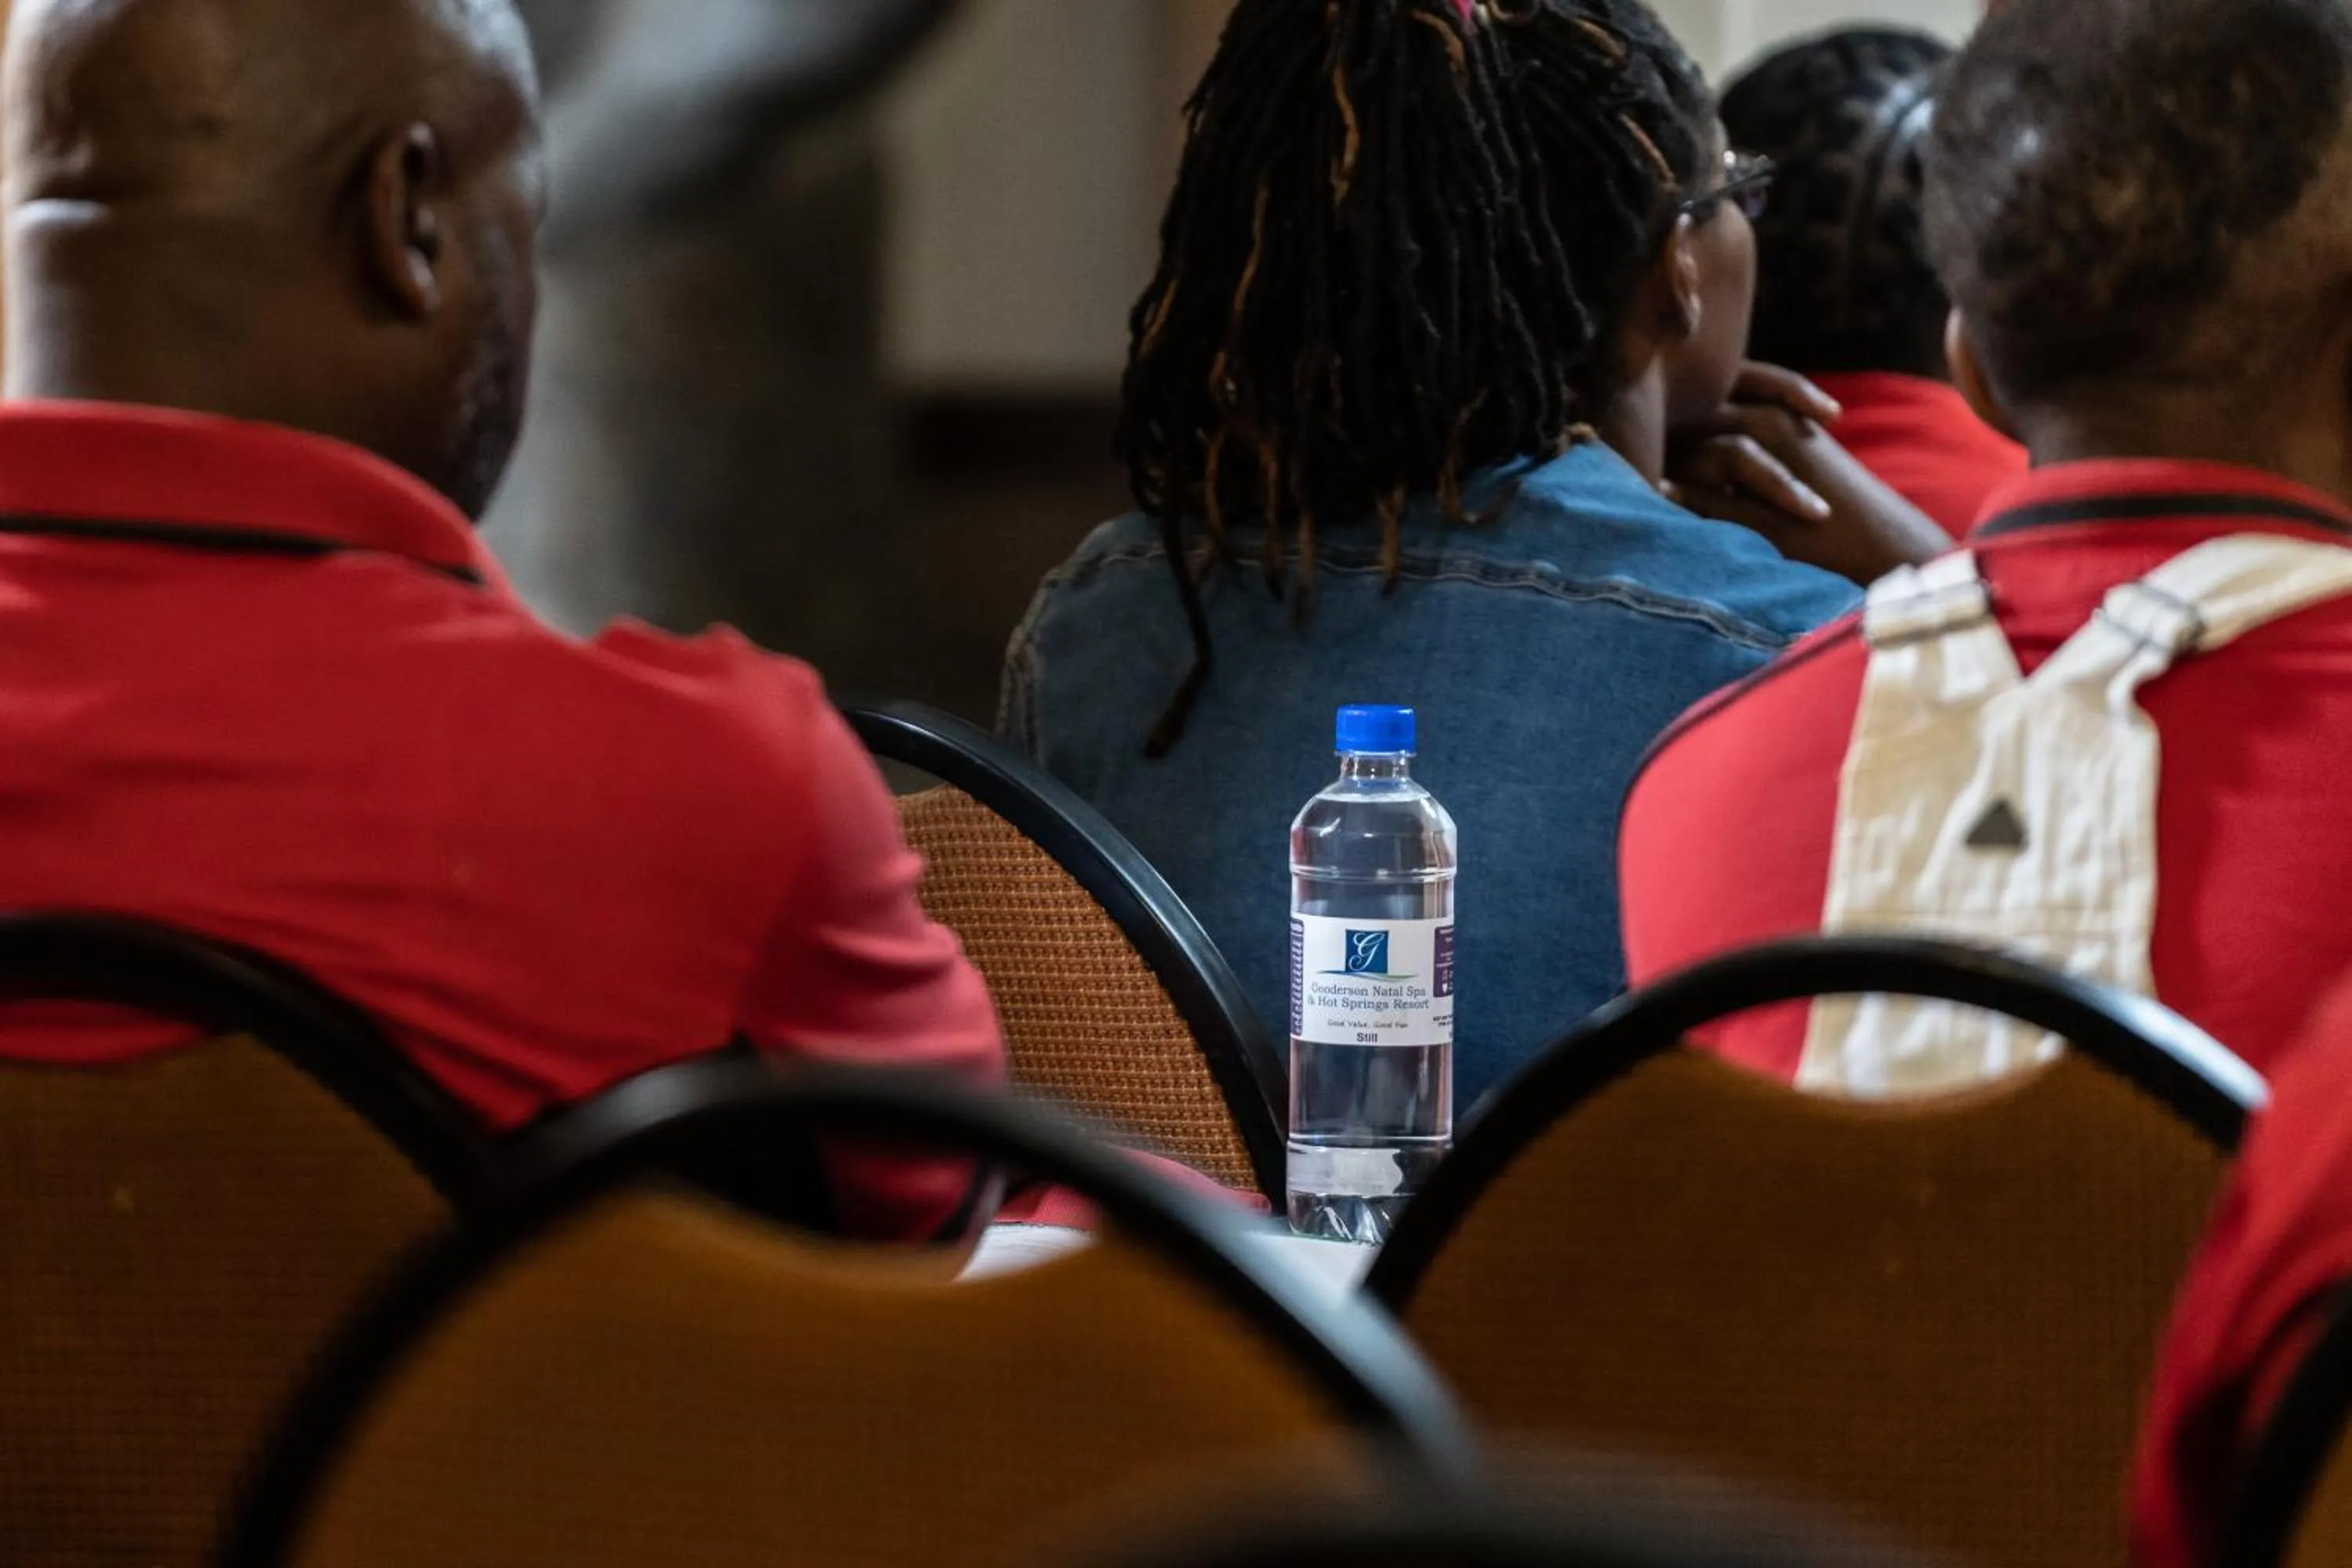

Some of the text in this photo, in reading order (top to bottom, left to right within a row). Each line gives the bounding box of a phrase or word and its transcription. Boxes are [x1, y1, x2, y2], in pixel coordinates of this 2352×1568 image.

[1311, 982, 1426, 999] Gooderson Natal Spa
[1317, 996, 1338, 1007] Hot
[1341, 997, 1389, 1011] Springs
[1393, 999, 1429, 1009] Resort
[1356, 1033, 1377, 1043] Still
